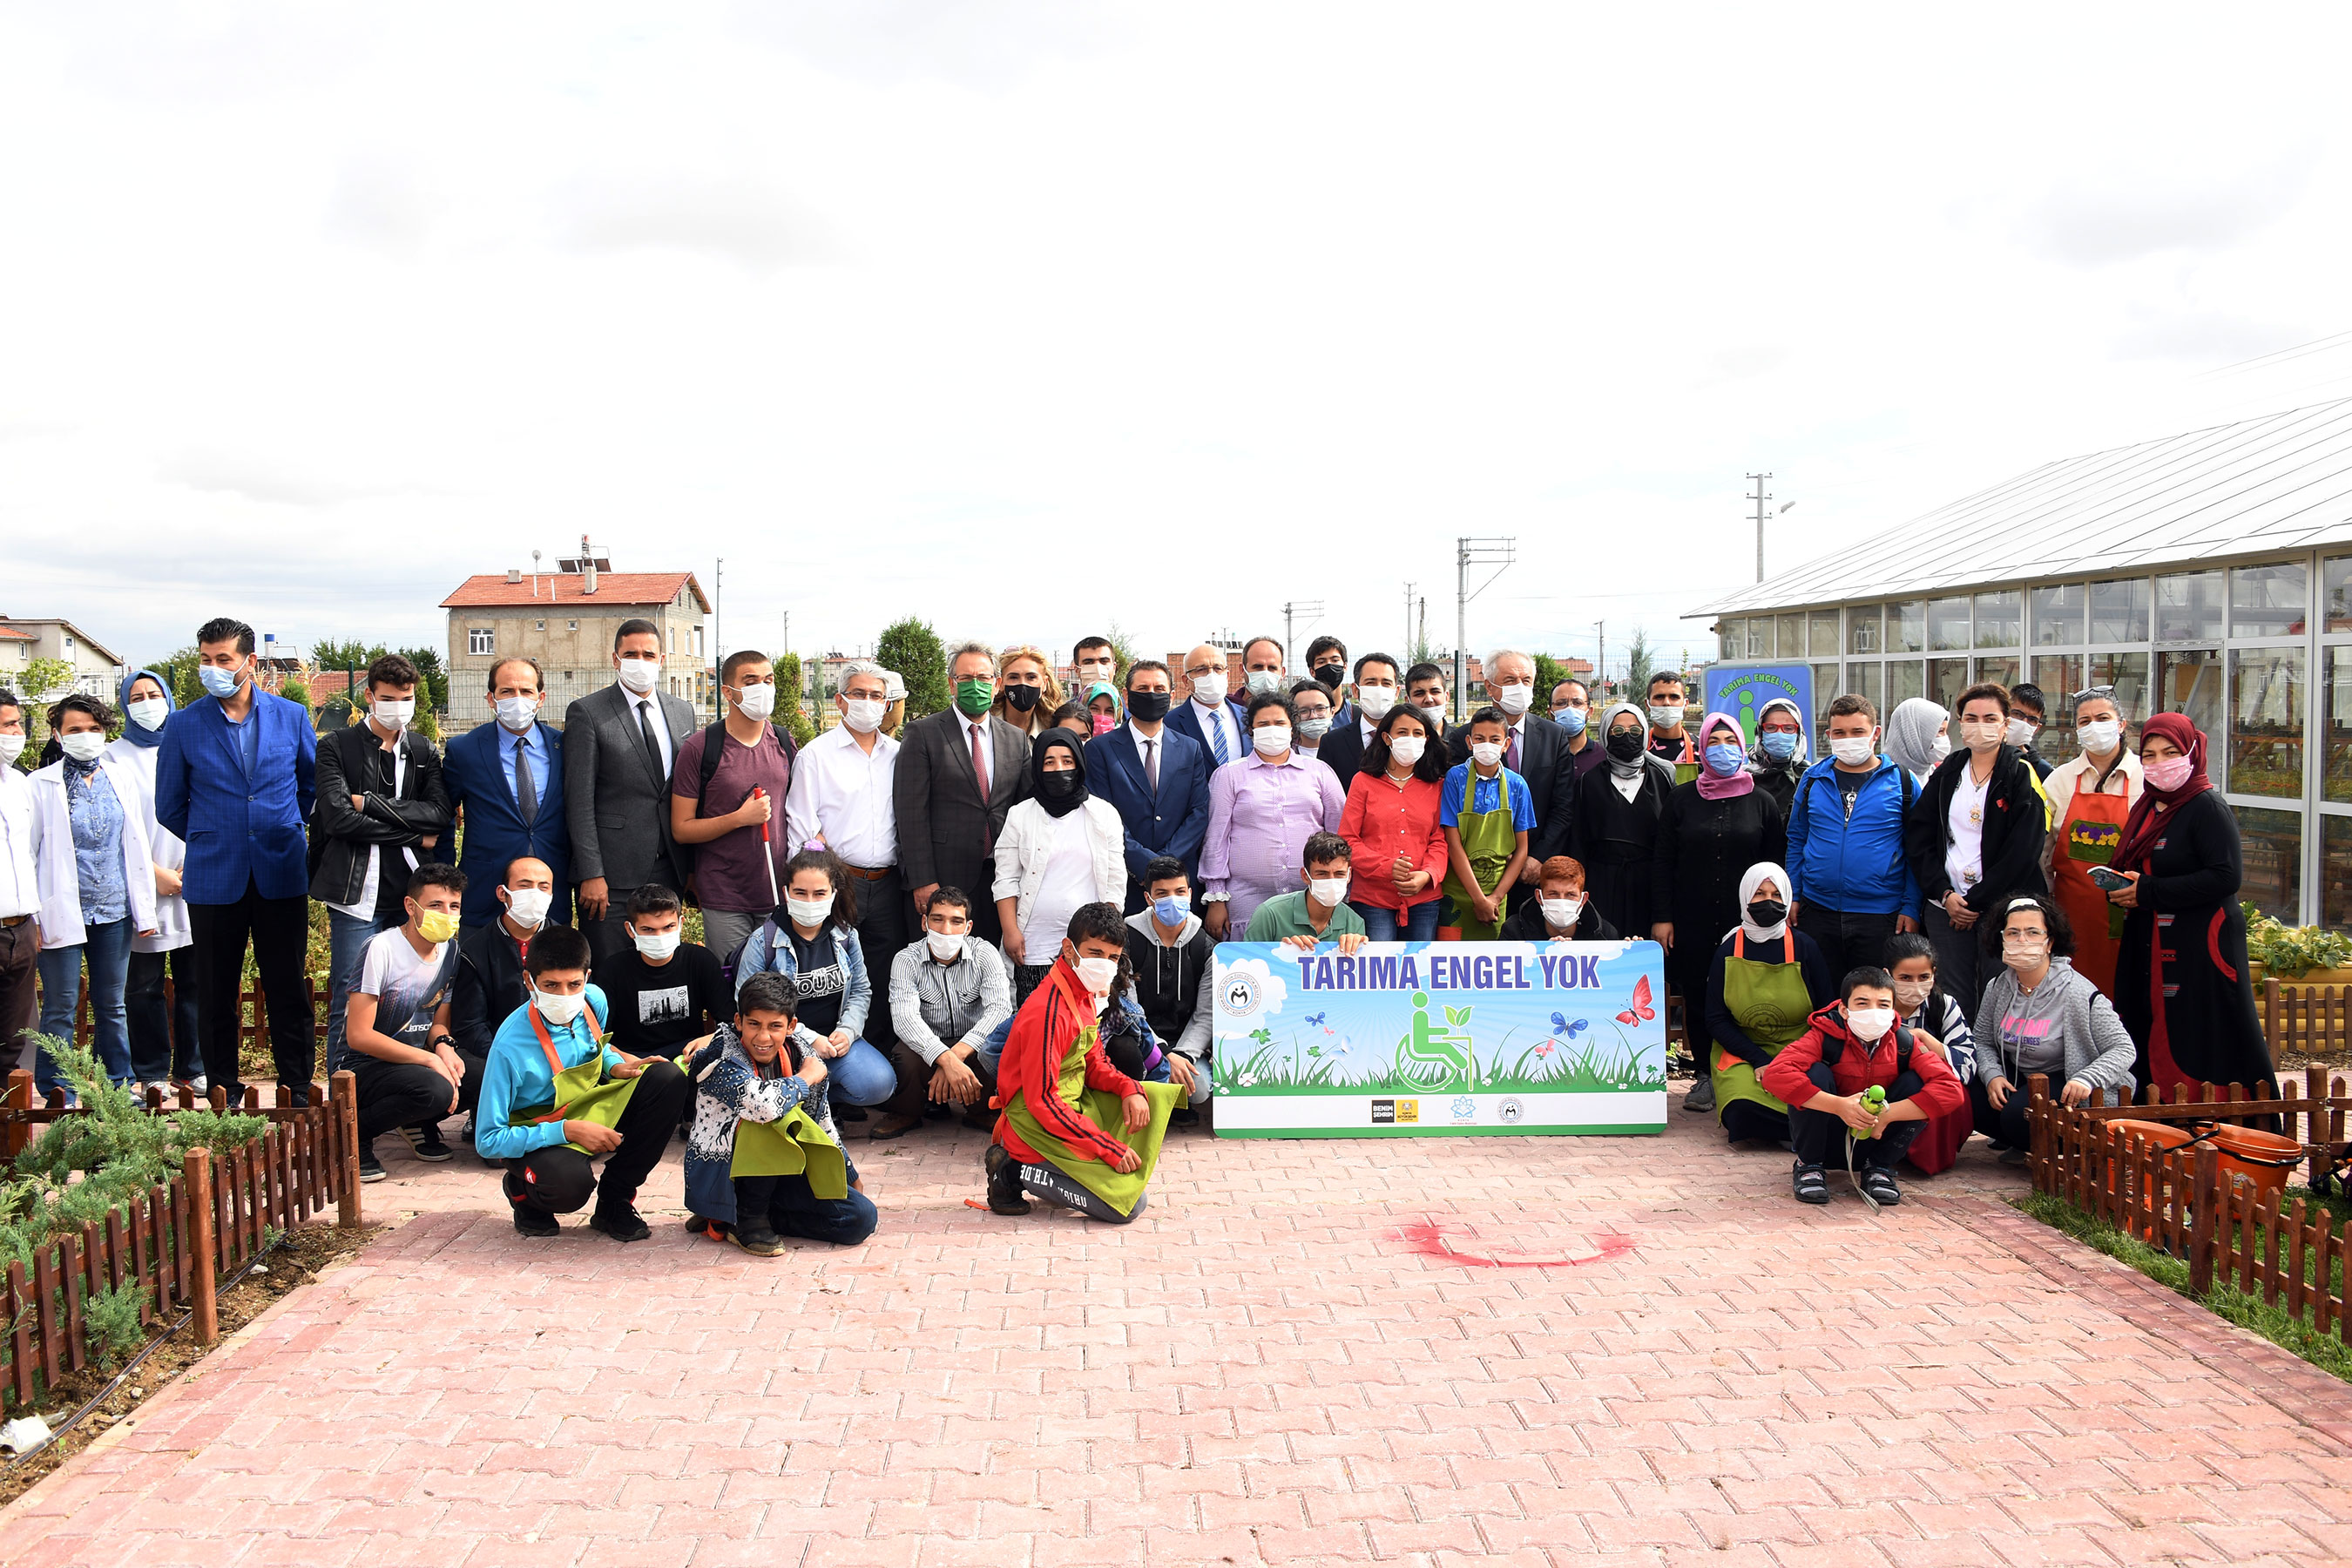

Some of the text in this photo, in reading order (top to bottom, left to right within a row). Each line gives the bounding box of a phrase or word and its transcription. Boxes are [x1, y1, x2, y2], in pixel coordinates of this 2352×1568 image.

[1718, 672, 1799, 699] TARIMA ENGEL YOK
[1297, 955, 1603, 990] TARIMA ENGEL YOK
